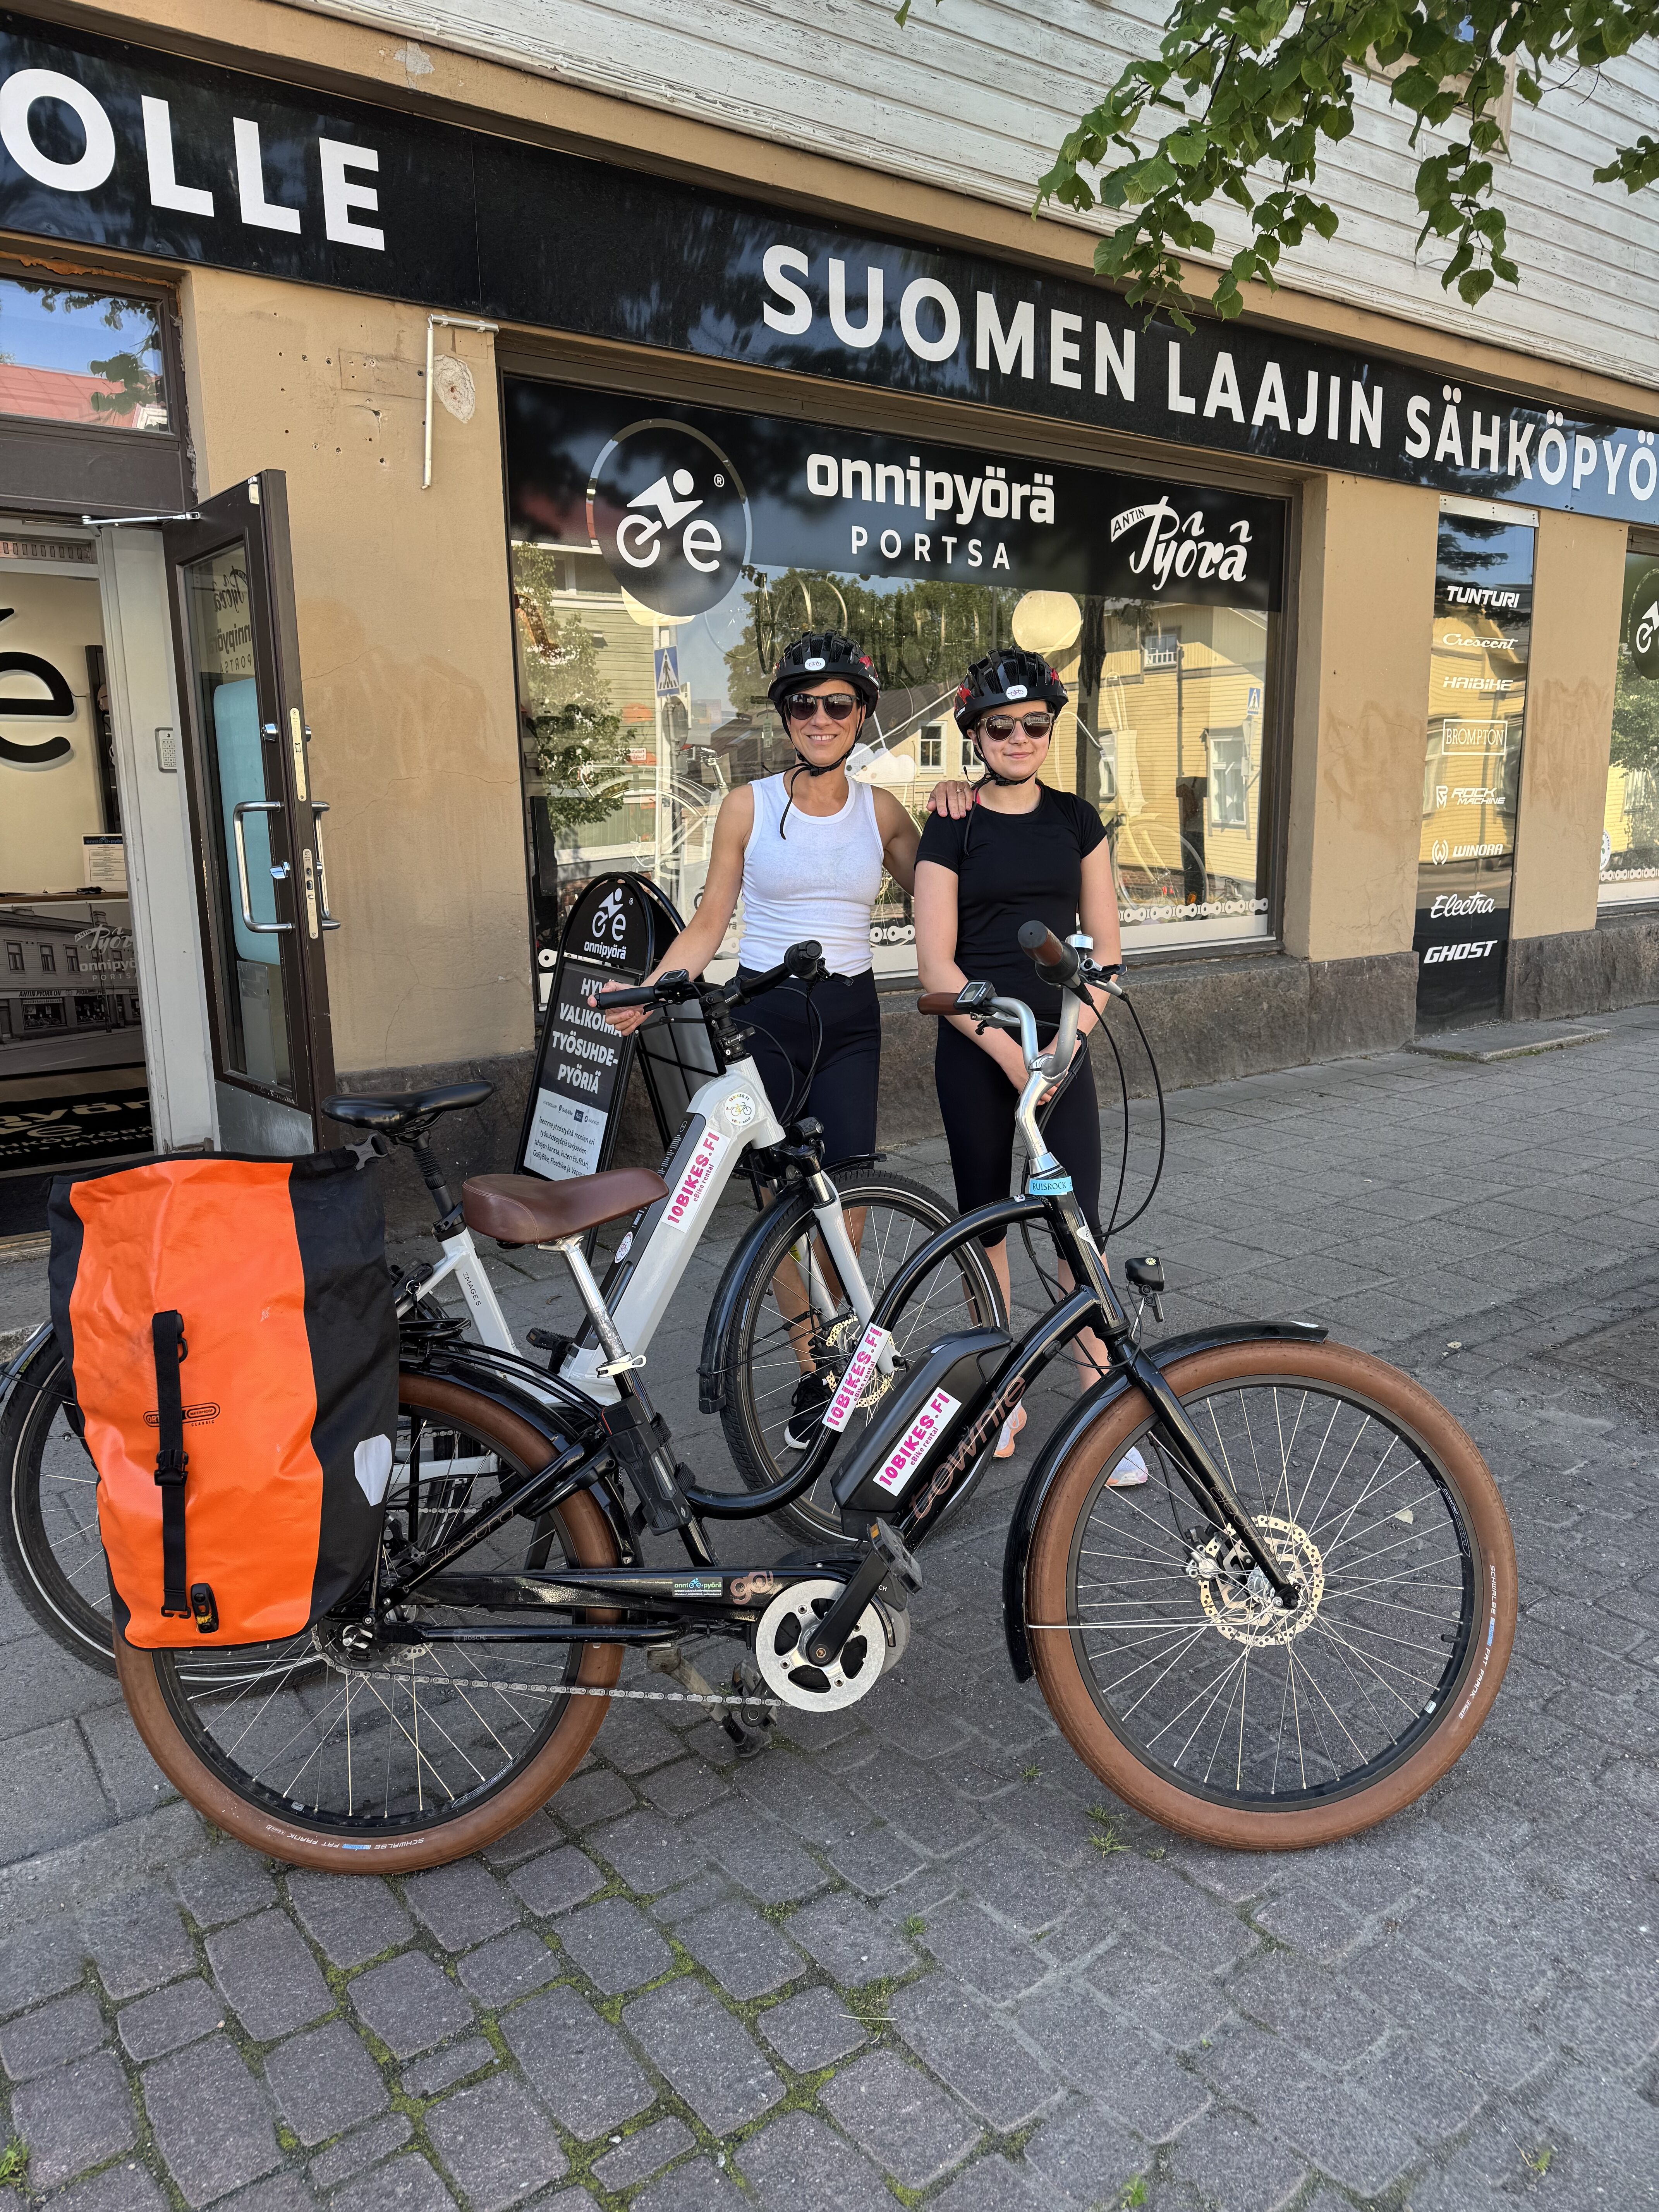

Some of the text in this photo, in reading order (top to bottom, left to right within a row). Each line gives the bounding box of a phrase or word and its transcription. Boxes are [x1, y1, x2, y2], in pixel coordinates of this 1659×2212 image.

[0, 69, 385, 251] OLLE
[763, 244, 1656, 501] SUOMEN LAAJIN SÄHKÖPYÖ
[807, 453, 1055, 526] onnipyörä
[1113, 508, 1145, 537] ANTIN
[852, 526, 1010, 570] PORTSA
[1447, 586, 1520, 608] TUNTURI
[1443, 634, 1518, 650] Crescent
[1446, 728, 1504, 745] BROMPTON
[1451, 787, 1497, 798] ROCK
[1457, 797, 1506, 805] MACHINE
[1452, 843, 1503, 857] WINORA
[1431, 891, 1496, 918] Electra
[584, 941, 627, 960] onnipyörä
[1424, 940, 1498, 963] GHOST
[79, 958, 135, 971] onnipyö
[93, 973, 136, 981] PORTS
[552, 1030, 618, 1066] TYÖSUHDE-
[557, 1063, 601, 1094] PYÖRIÄ
[60, 1133, 153, 1148] LAPPEE
[668, 1132, 720, 1224] 10BIKES.FI
[693, 1164, 714, 1202] eBike rental
[1032, 1182, 1066, 1192] RUISROCK
[462, 1272, 479, 1300] IMAGE
[827, 1327, 883, 1426] 10BIKES.FI
[853, 1361, 876, 1402] eBike rental
[879, 1393, 950, 1486] 10BIKES.FI
[910, 1427, 939, 1466] eBike rental
[1482, 1648, 1491, 1667] FAT
[1470, 1669, 1484, 1699] FRANK
[287, 1833, 319, 1844] FRANK
[374, 1837, 424, 1850] SCHWALBE
